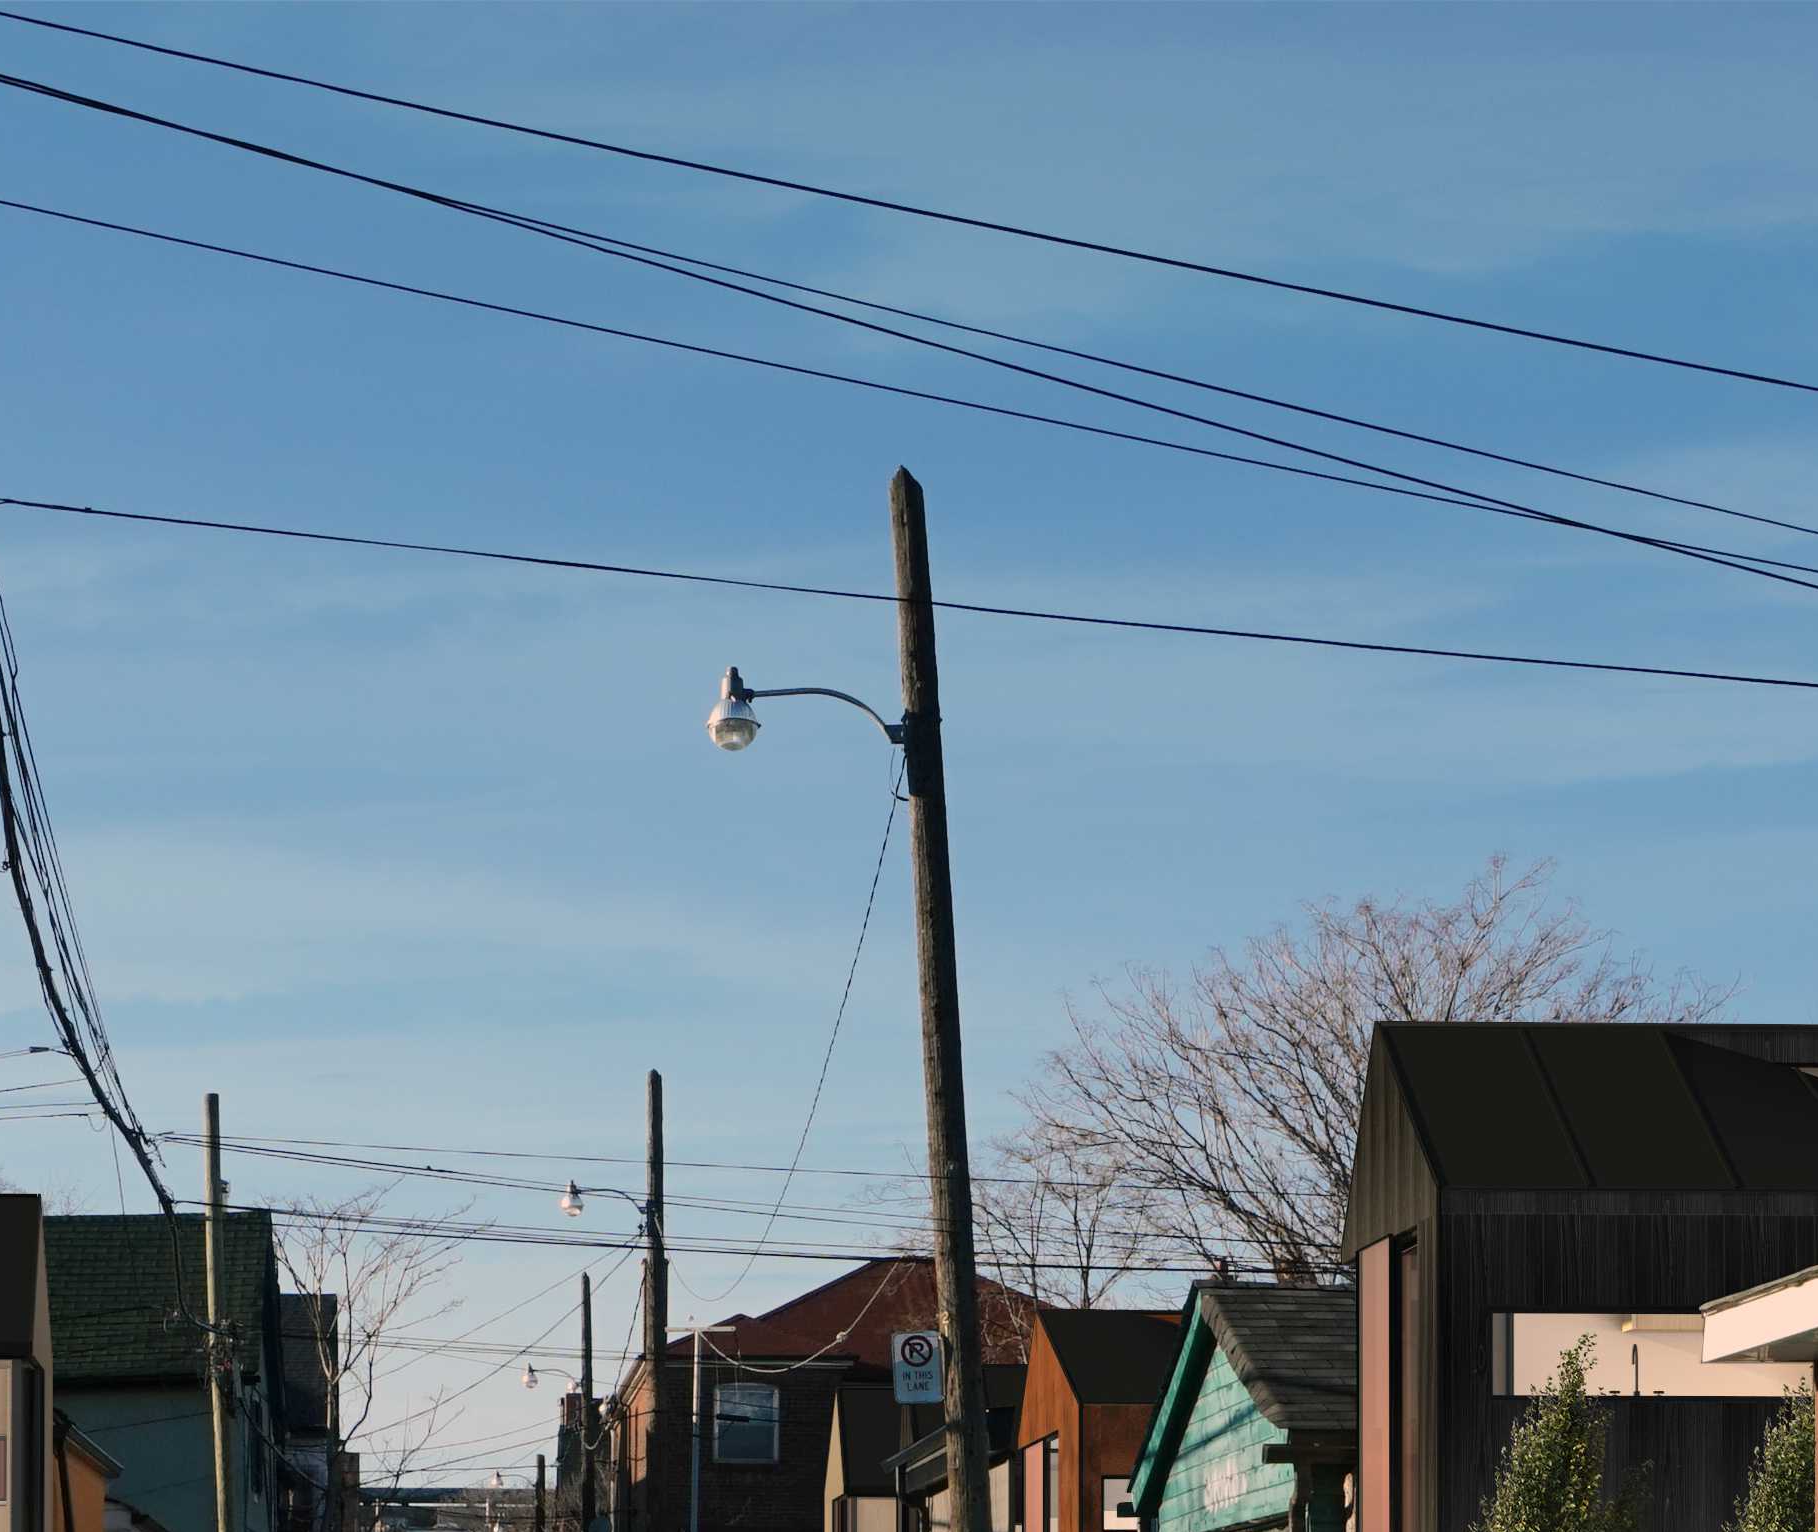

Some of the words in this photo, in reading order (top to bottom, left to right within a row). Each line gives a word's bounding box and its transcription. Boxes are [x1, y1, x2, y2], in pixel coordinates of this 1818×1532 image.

[902, 1371, 911, 1380] IN
[915, 1370, 933, 1380] THIS
[907, 1381, 930, 1392] LANE
